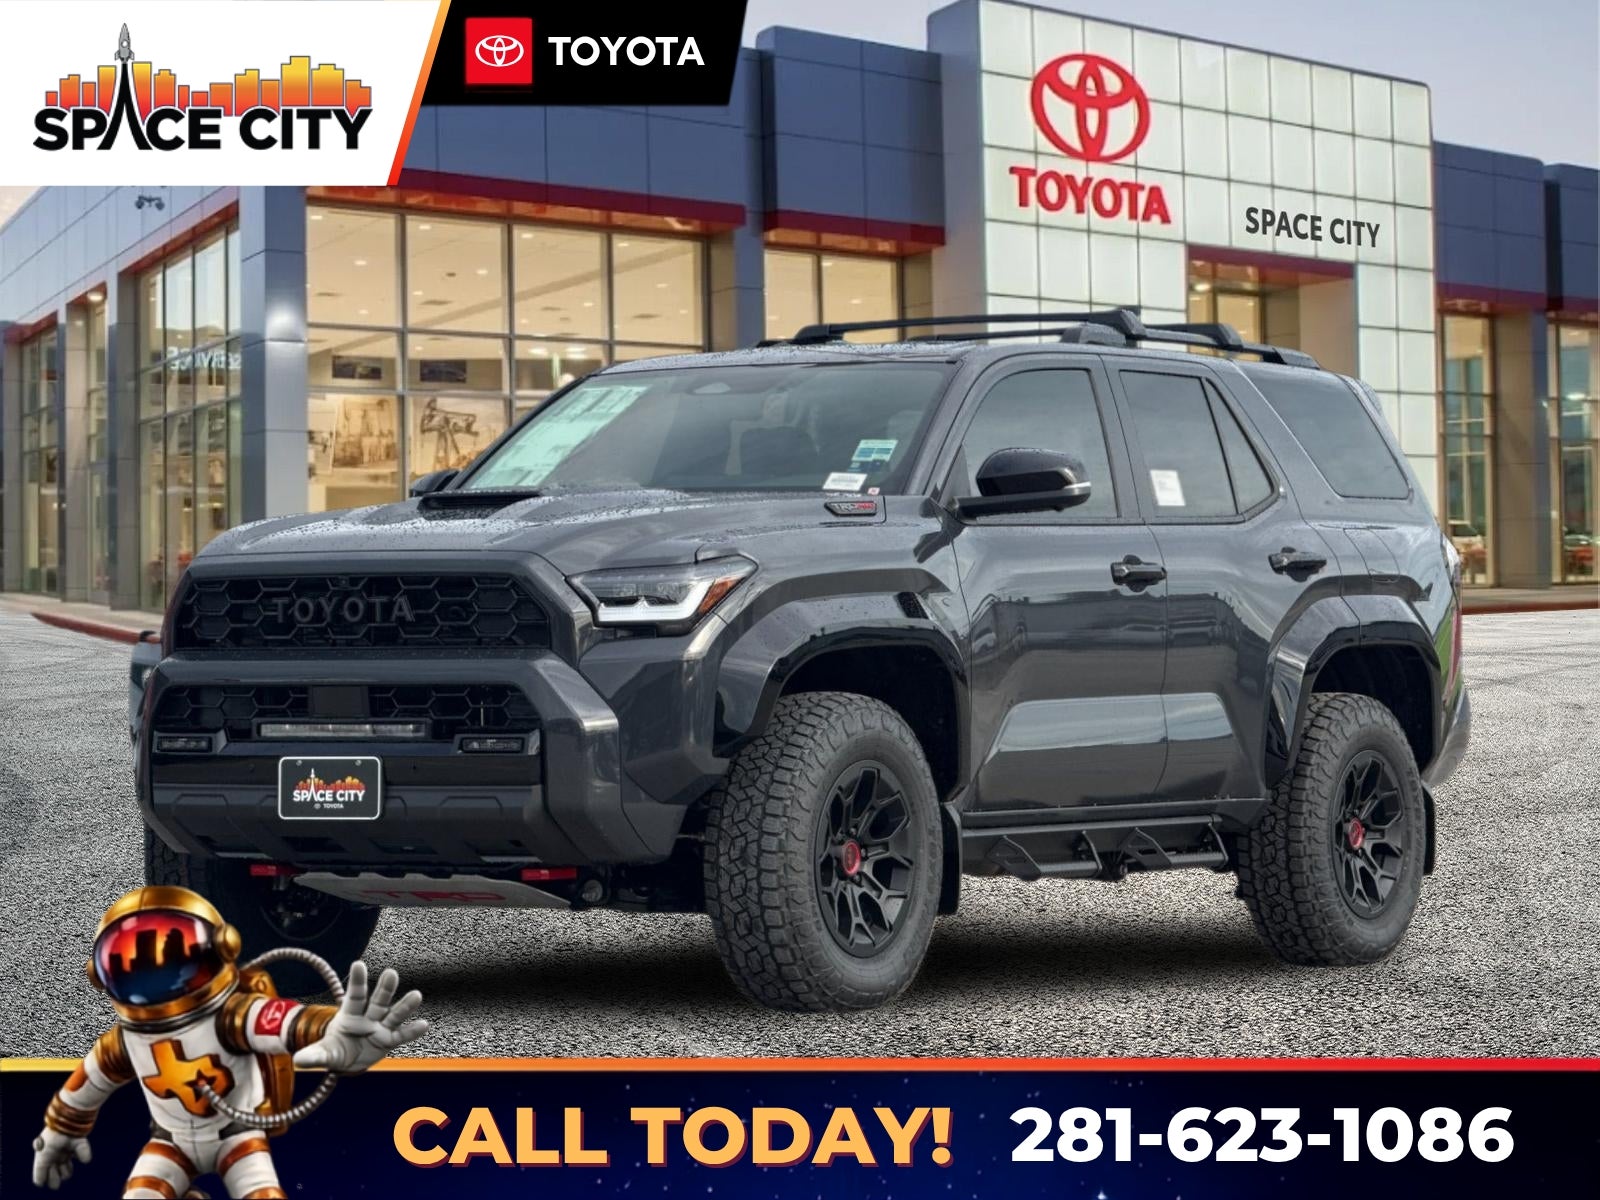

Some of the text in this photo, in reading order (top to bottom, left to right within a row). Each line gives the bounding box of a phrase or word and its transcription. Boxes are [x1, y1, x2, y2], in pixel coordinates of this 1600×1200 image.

[1009, 166, 1171, 225] TOYOTA
[1245, 206, 1381, 248] SPACE CITY
[271, 595, 416, 624] TOYOTA
[293, 789, 366, 802] SPACE CITY
